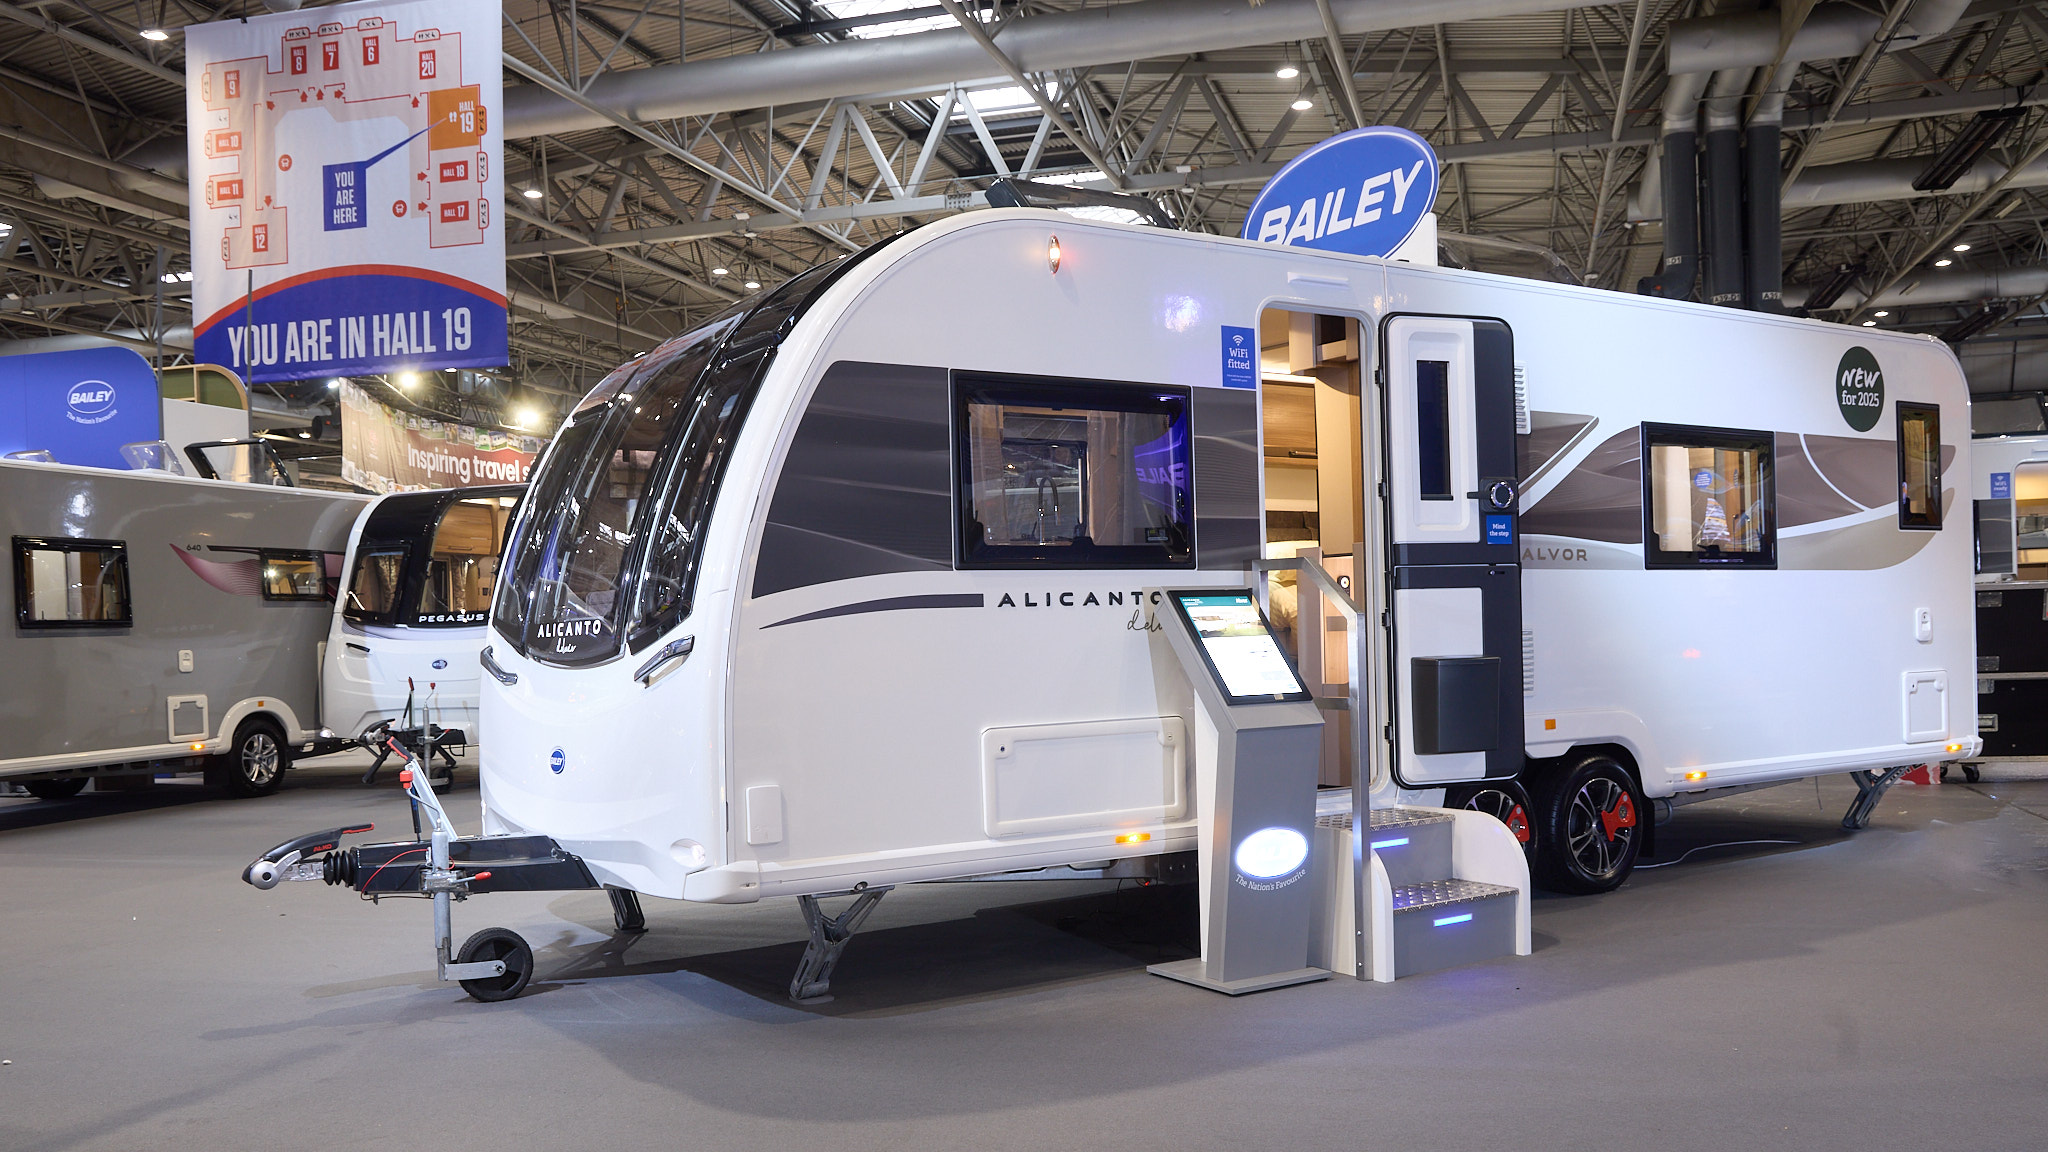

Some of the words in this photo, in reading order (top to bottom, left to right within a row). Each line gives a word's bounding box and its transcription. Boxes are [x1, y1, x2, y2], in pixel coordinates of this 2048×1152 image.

[325, 44, 337, 52] HALL
[364, 38, 377, 47] HALL
[292, 48, 304, 56] HALL
[328, 52, 335, 67] 7
[367, 46, 375, 62] 6
[421, 52, 434, 60] HALL
[295, 56, 303, 71] 8
[421, 60, 435, 76] 20
[226, 72, 238, 80] HALL
[229, 80, 236, 95] 9
[459, 101, 475, 112] HALL
[459, 111, 474, 133] 19
[218, 139, 230, 148] HALL
[230, 135, 239, 148] 10
[443, 168, 455, 177] HALL
[455, 164, 465, 177] 18
[334, 171, 355, 188] YOU
[219, 186, 231, 195] HALL
[231, 183, 239, 195] 11
[336, 189, 355, 206] ARE
[1257, 159, 1424, 246] BAILEY
[333, 207, 357, 225] HERE
[443, 208, 456, 218] HALL
[457, 205, 466, 218] 17
[254, 226, 266, 234] HALL
[255, 234, 266, 249] 12
[227, 322, 278, 368] YOU
[284, 318, 333, 364] ARE
[339, 315, 366, 360] IN
[372, 310, 437, 357] HALL
[442, 307, 472, 352] 19
[1228, 347, 1248, 358] WiFi
[1227, 358, 1250, 370] fitted
[1841, 367, 1880, 388] NEW
[70, 390, 113, 405] BAILEY
[1841, 390, 1857, 405] for
[1858, 391, 1880, 407] 2025
[407, 443, 471, 484] Inspiring
[473, 455, 520, 482] travel
[1499, 530, 1510, 538] step
[186, 544, 202, 552] 640
[1522, 547, 1588, 562] ALVOR
[998, 591, 1163, 608] ALICANTO
[418, 613, 485, 623] PEGASUS
[537, 619, 601, 638] ALICANTO
[1235, 873, 1248, 888] The
[1247, 880, 1275, 891] Nation's
[1275, 868, 1306, 890] Favourite
